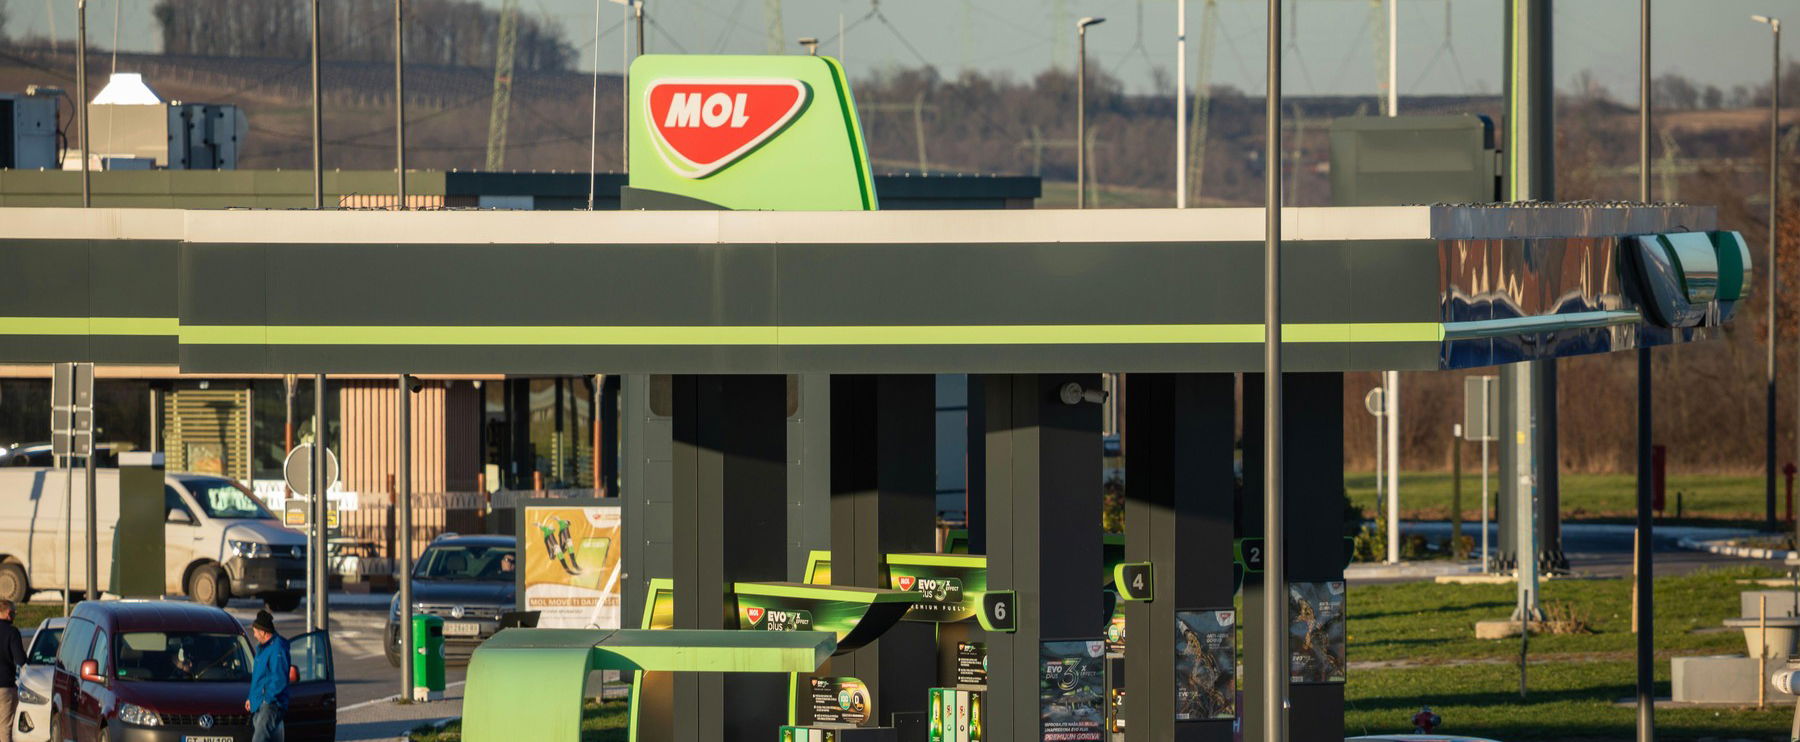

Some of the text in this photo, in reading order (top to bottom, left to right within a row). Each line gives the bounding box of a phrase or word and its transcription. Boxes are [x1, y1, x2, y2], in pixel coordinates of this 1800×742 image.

[663, 92, 750, 128] MOL
[1250, 547, 1260, 563] 2
[918, 579, 936, 590] EVO
[1132, 573, 1144, 590] 4
[767, 610, 787, 622] EVO
[994, 601, 1006, 620] 6
